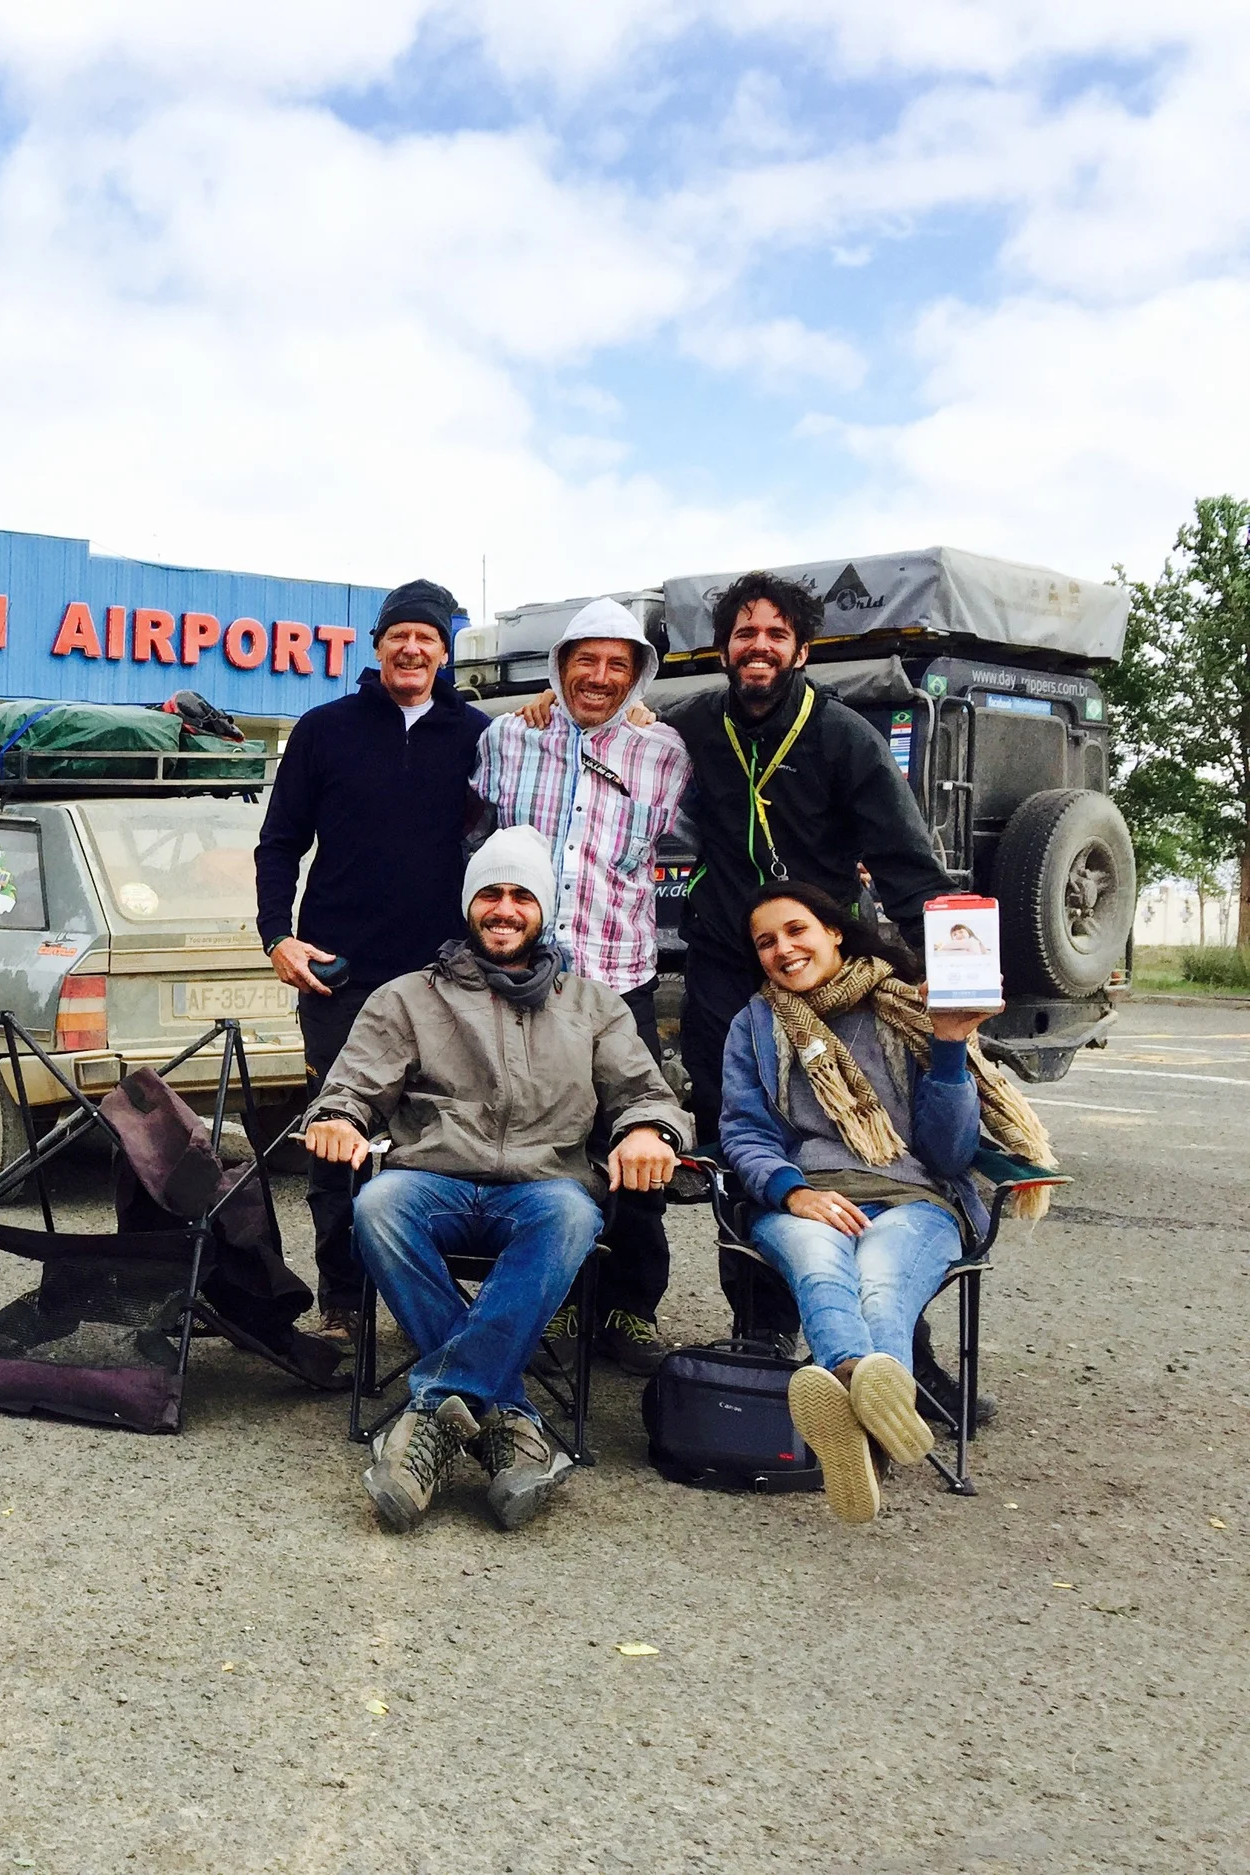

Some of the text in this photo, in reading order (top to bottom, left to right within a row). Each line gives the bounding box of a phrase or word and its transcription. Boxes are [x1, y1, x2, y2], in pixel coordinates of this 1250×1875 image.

[51, 601, 356, 677] AIRPORT
[189, 986, 289, 1011] AF-357-FD
[718, 1402, 743, 1412] Canon
